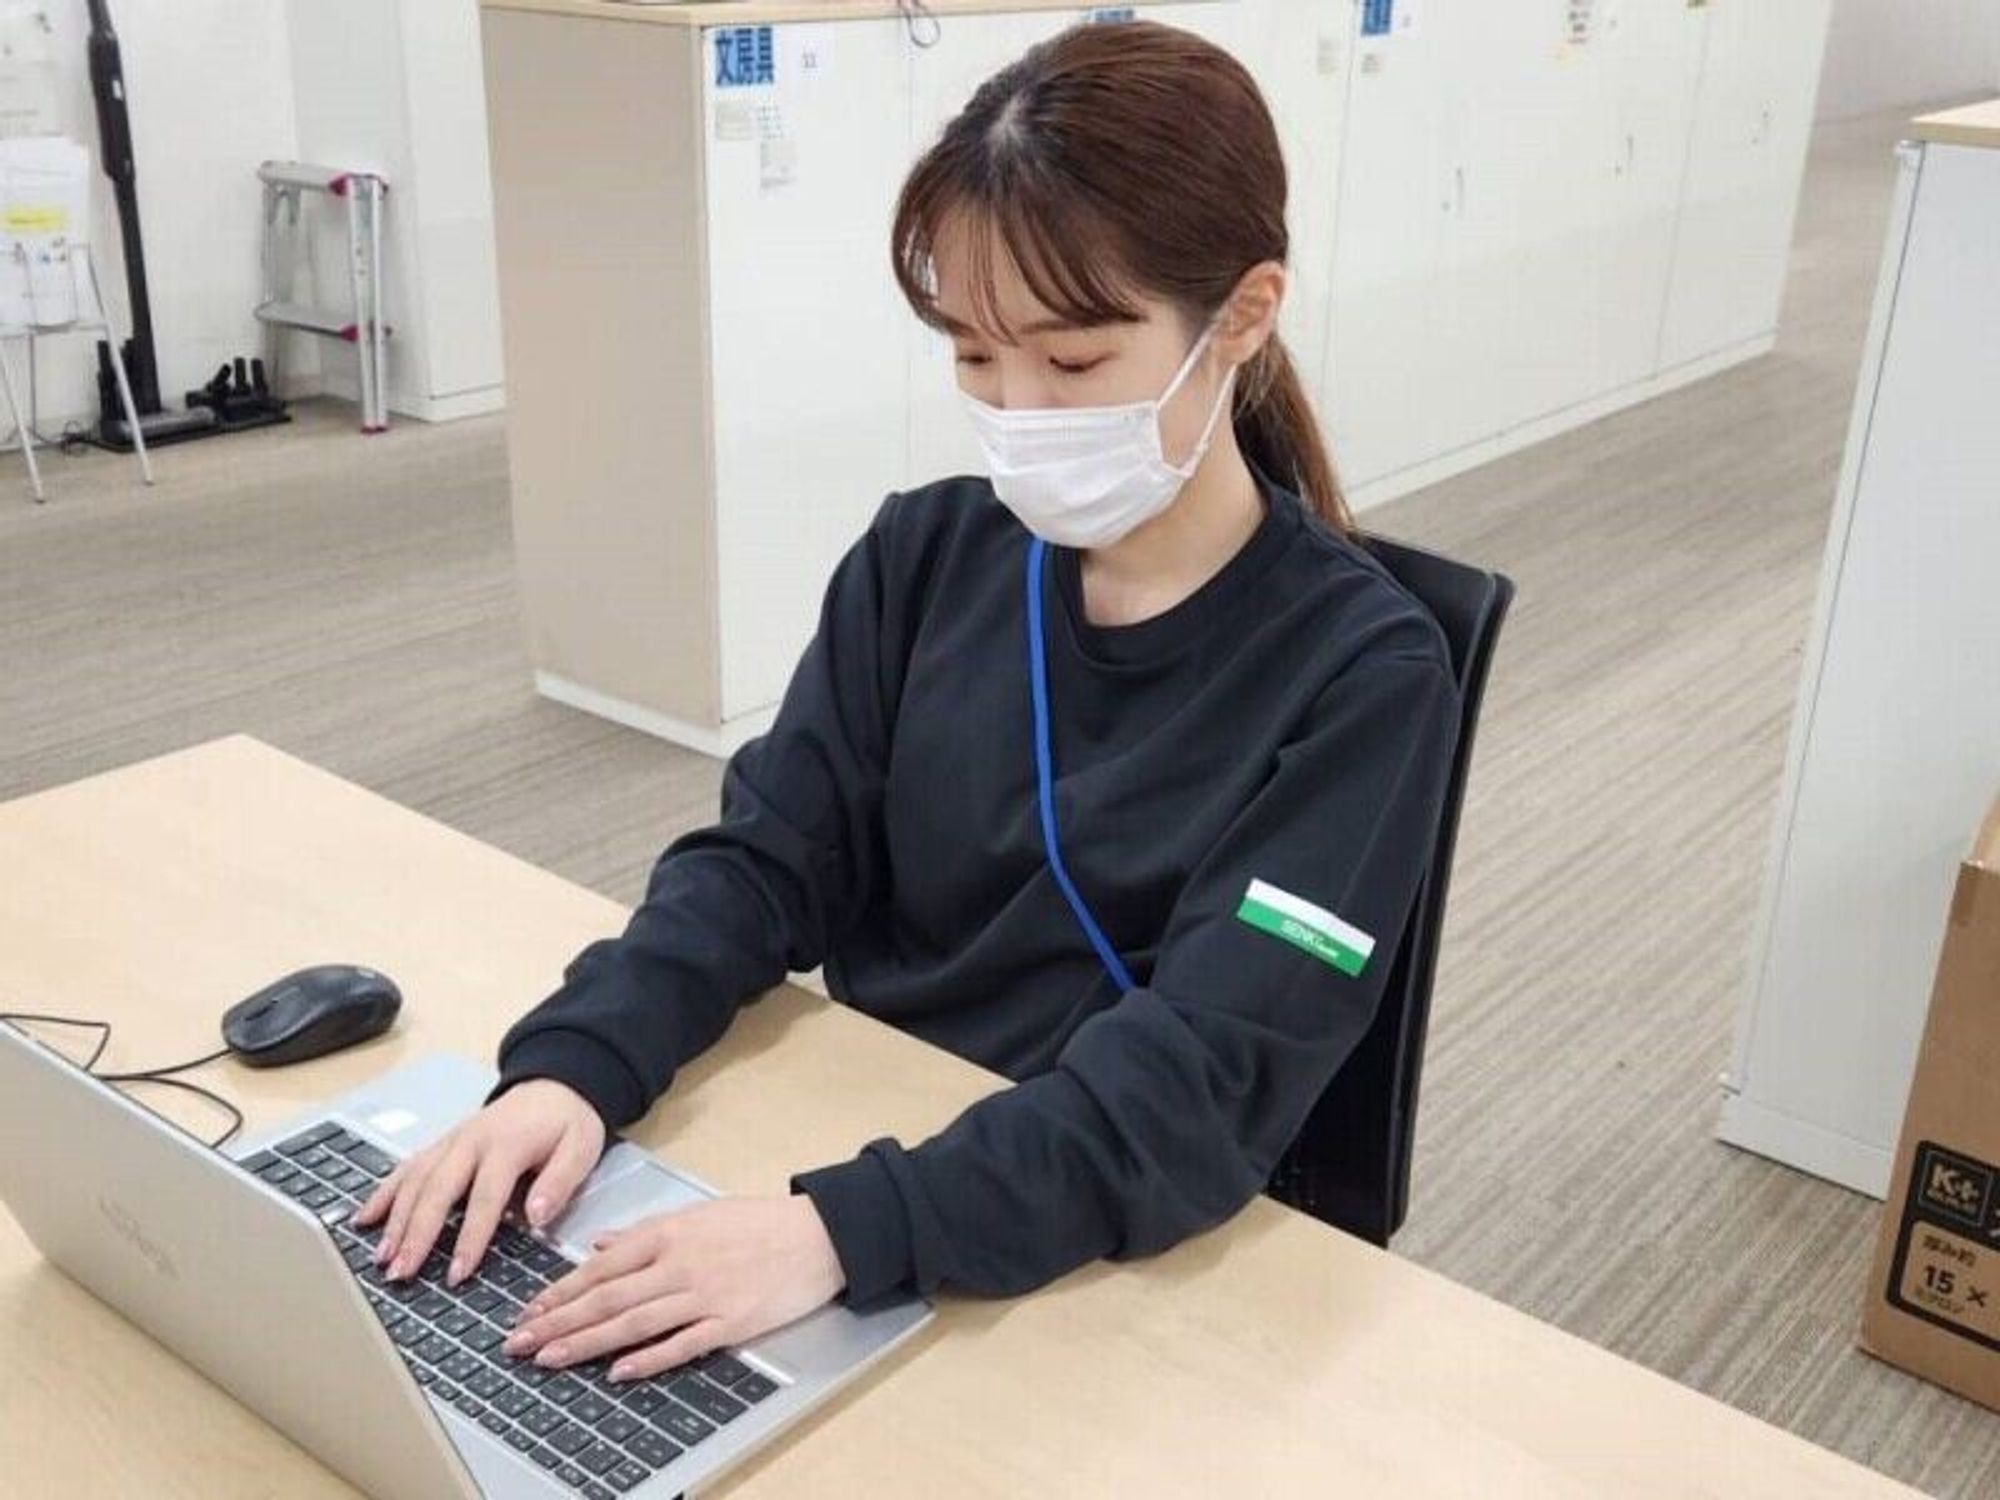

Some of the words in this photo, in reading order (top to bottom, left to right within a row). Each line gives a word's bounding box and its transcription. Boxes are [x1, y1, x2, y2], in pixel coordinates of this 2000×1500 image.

[715, 27, 774, 86] 文房具
[1925, 1265, 1955, 1294] 15
